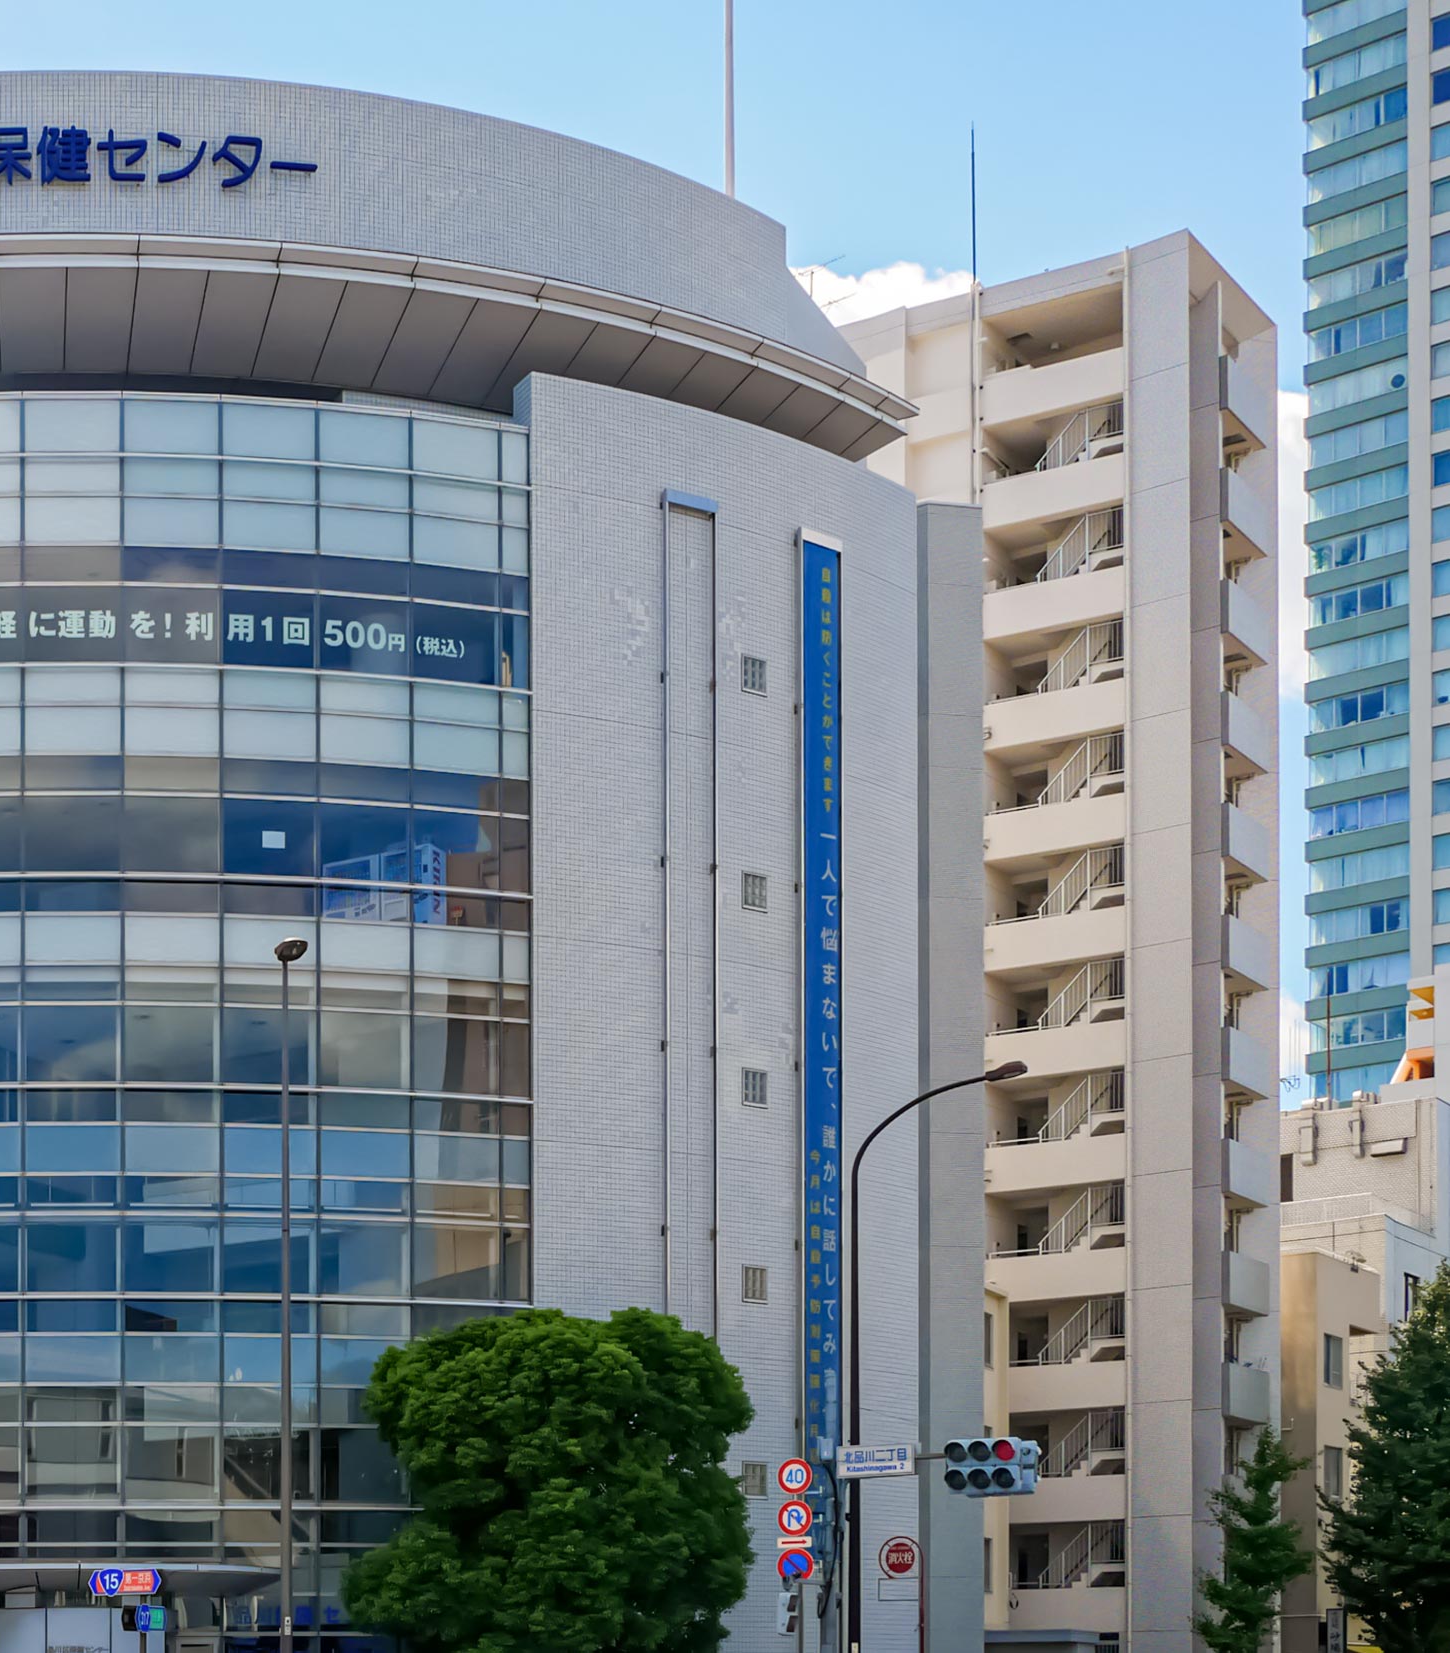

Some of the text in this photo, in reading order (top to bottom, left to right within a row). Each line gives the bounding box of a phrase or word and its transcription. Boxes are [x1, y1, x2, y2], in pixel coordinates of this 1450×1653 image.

[820, 832, 838, 1385] 一人で悩まないで、誰かに話してみ
[844, 1447, 907, 1464] 北品川二丁目
[846, 1462, 905, 1472] Kitashinagawa 2
[785, 1468, 804, 1484] 40
[888, 1551, 913, 1564] 消火栓
[103, 1573, 119, 1590] 15
